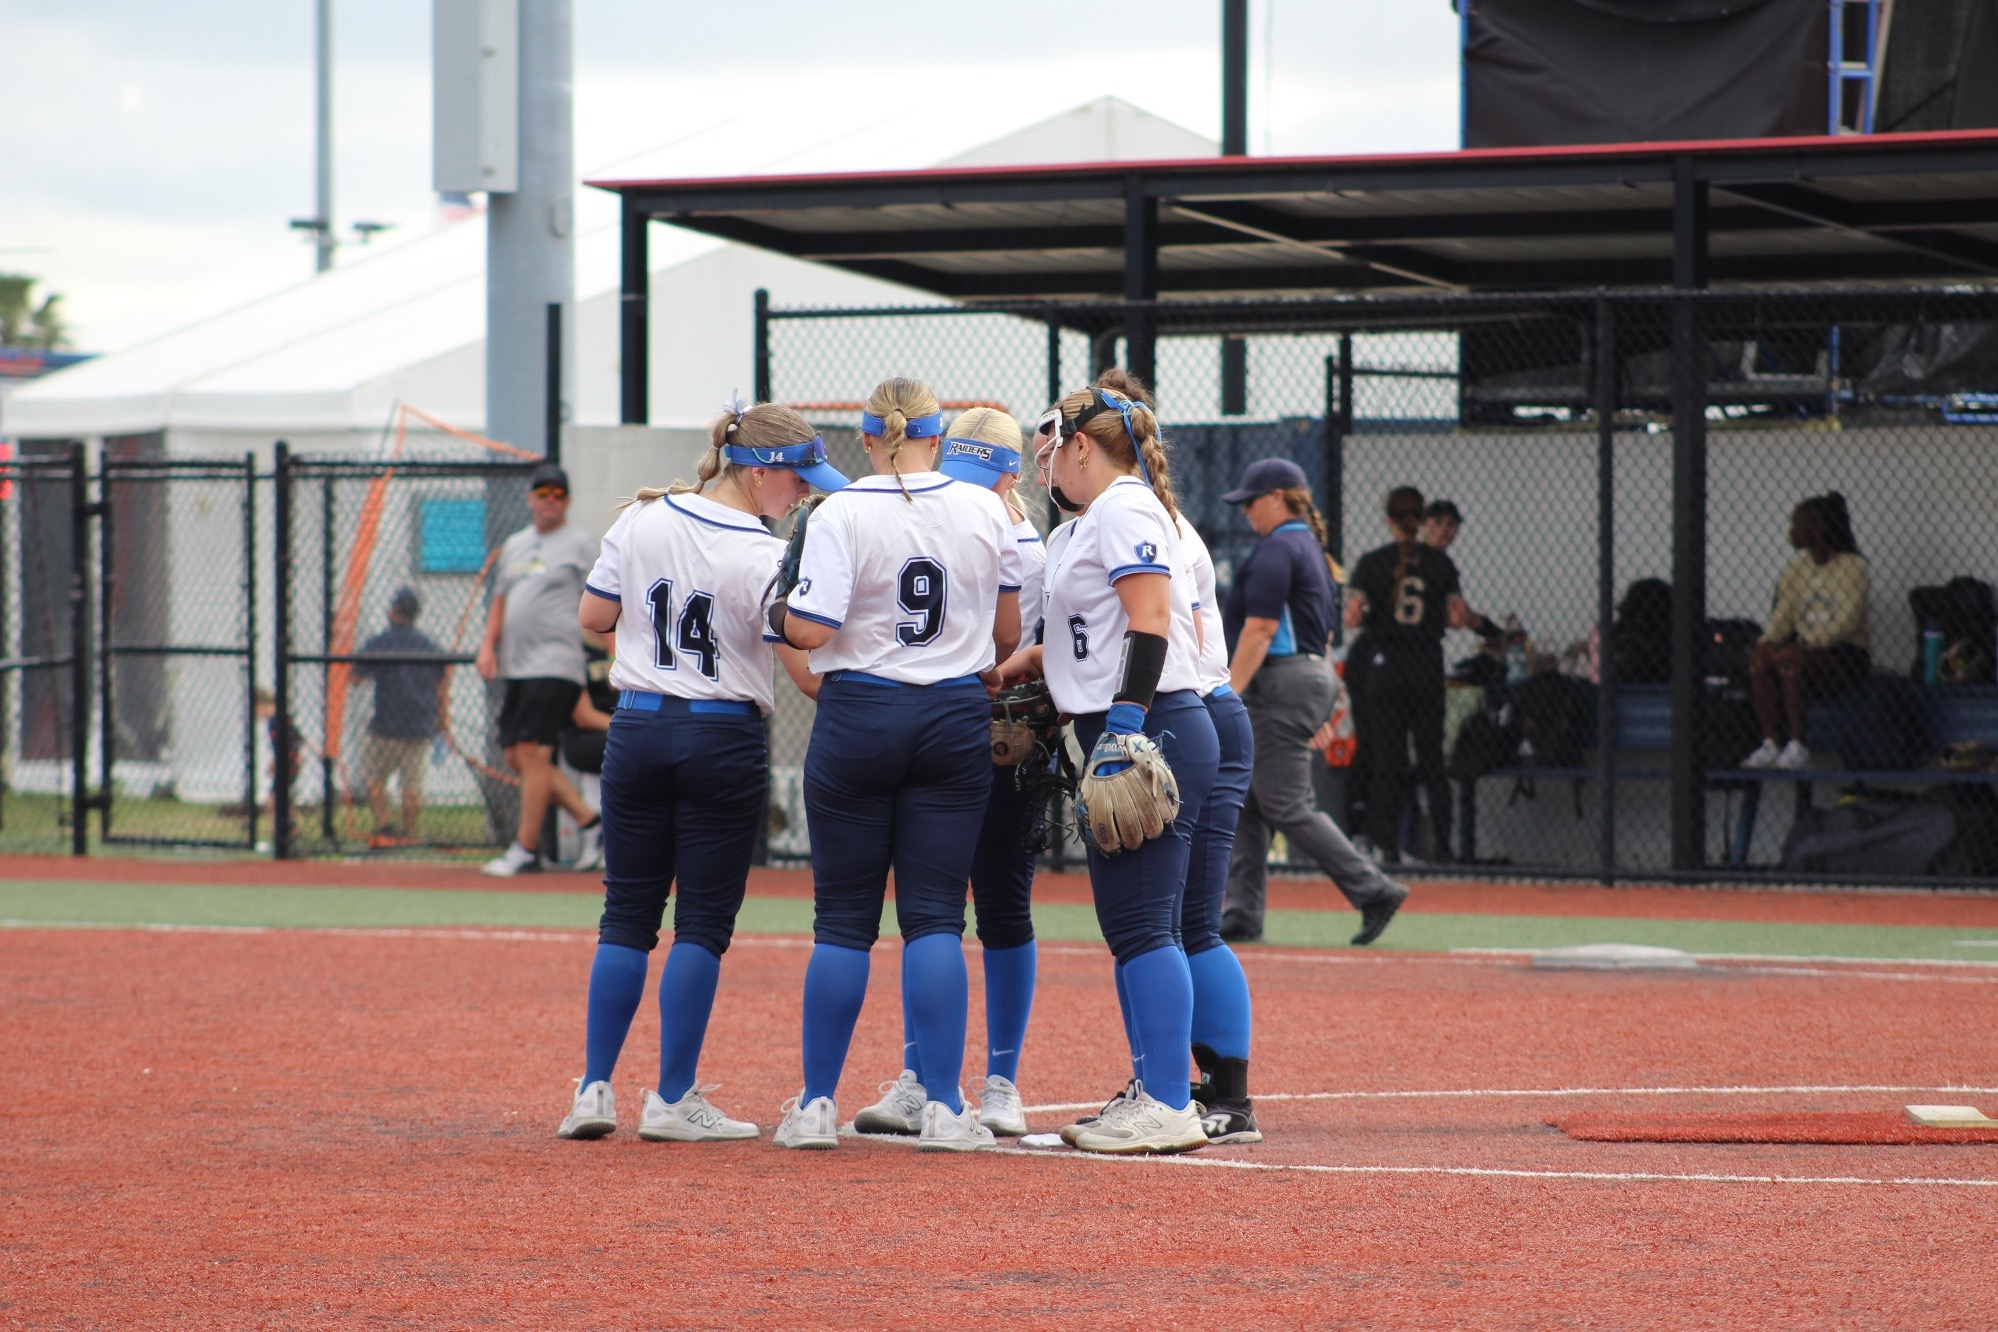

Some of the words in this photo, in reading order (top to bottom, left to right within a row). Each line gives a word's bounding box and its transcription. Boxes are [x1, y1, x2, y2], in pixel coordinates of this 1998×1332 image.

[769, 451, 784, 463] 14
[947, 442, 993, 461] RAIDERS
[1142, 545, 1154, 557] R
[896, 556, 948, 648] 9
[1394, 576, 1425, 625] 6
[646, 577, 720, 682] 14
[1068, 613, 1090, 663] 6
